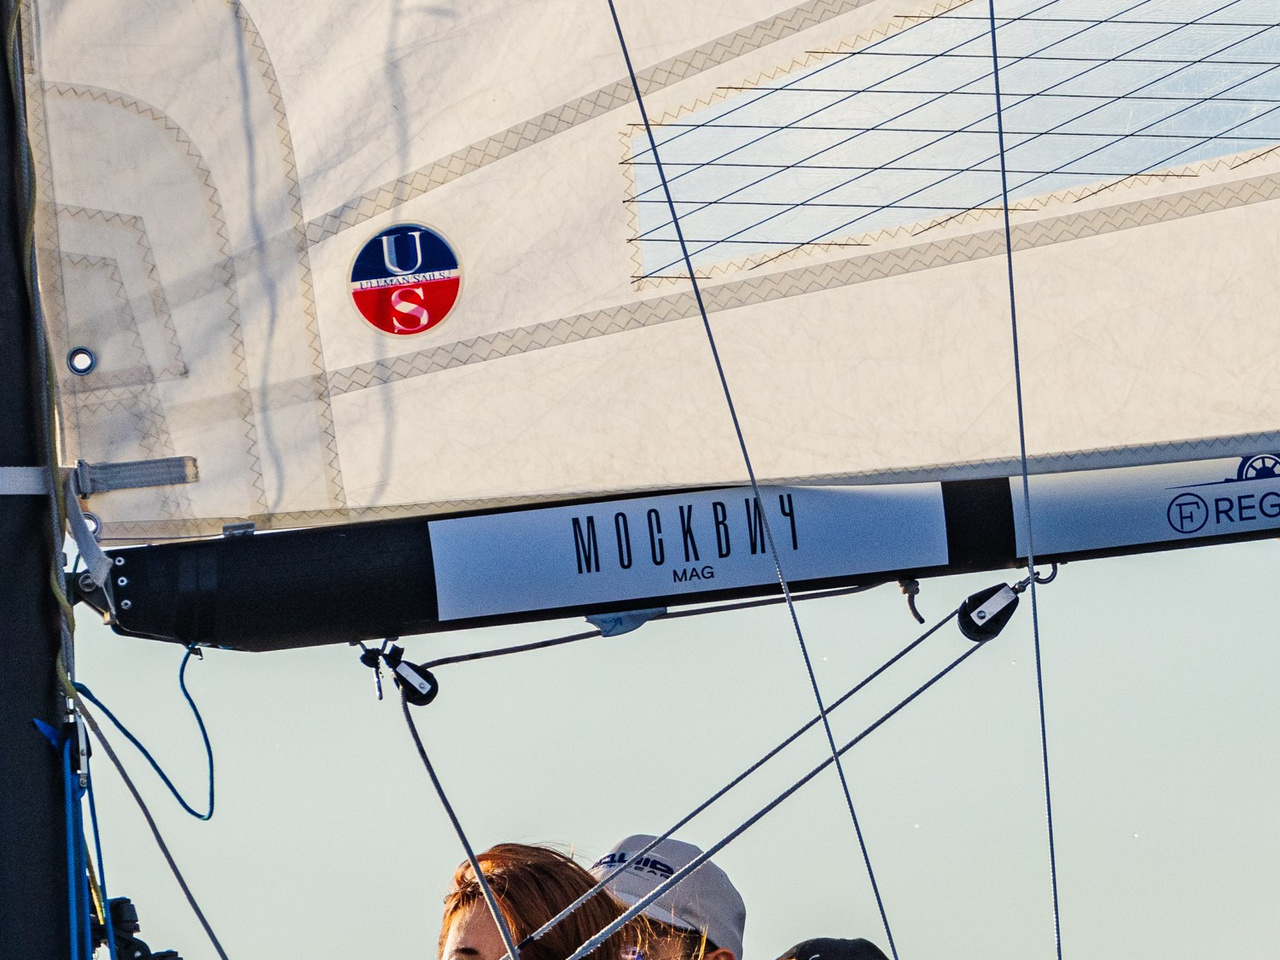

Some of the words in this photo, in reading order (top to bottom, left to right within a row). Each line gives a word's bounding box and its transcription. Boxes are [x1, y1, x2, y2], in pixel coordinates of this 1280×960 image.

[376, 231, 425, 275] U
[360, 276, 410, 290] ULLMAN
[413, 271, 446, 284] SAILS
[391, 287, 429, 333] S
[571, 493, 799, 574] МОСКВИЧ
[672, 565, 716, 583] MAG
